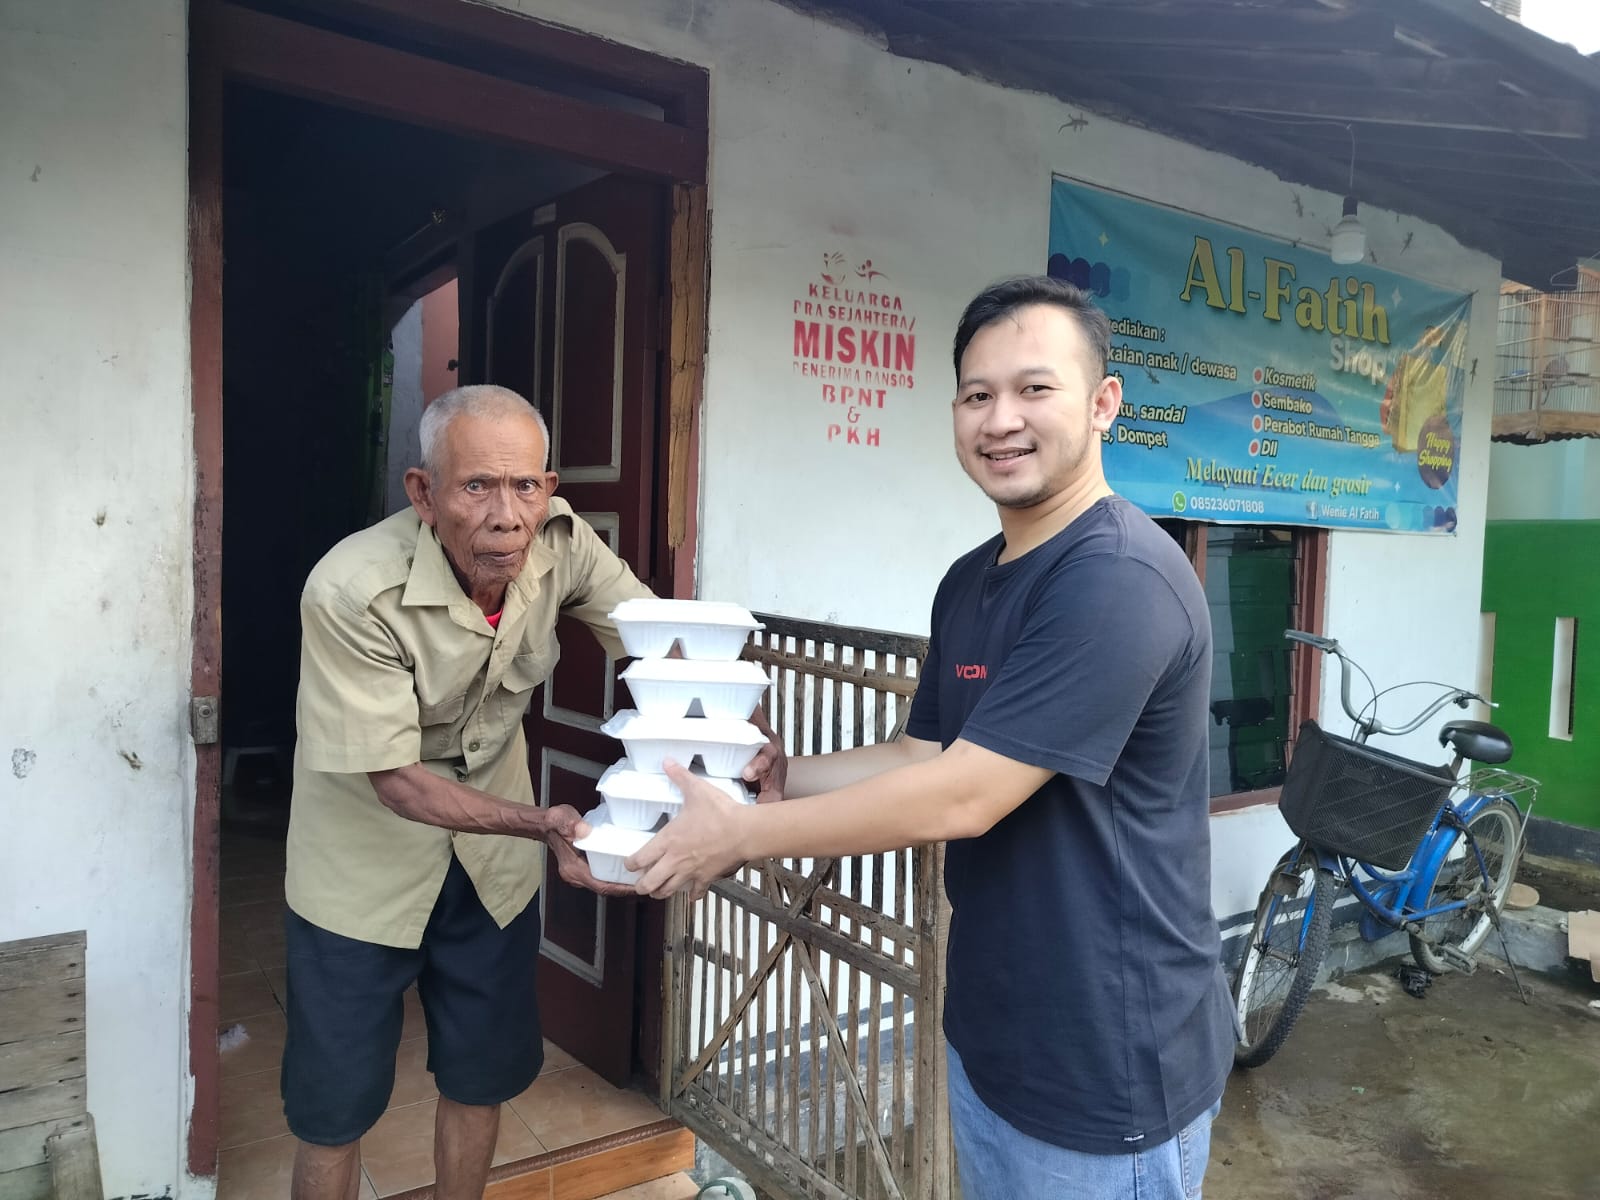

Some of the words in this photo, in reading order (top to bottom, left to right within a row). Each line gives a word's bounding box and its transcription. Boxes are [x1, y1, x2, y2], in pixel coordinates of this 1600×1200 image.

[808, 283, 902, 311] KELUARGA
[1180, 235, 1390, 344] Al-Fatih
[794, 319, 915, 371] MISKIN
[1147, 352, 1179, 371] anak
[1191, 358, 1238, 380] dewasa
[1330, 337, 1388, 386] Shop
[1264, 368, 1317, 391] Kosmetik
[823, 384, 887, 409] BPNT
[1263, 392, 1313, 414] Sembako
[847, 406, 860, 423] &
[1140, 404, 1187, 423] sandal
[828, 424, 880, 447] PKH
[1117, 425, 1168, 448] Dompet
[1264, 415, 1306, 436] Perabot
[1308, 421, 1344, 441] Rumah
[1345, 427, 1381, 448] Tangga
[1426, 431, 1451, 454] Happy
[1418, 448, 1453, 473] Shopping
[1185, 457, 1259, 488] Melayani
[1262, 464, 1299, 488] Ecer
[1302, 469, 1328, 491] dan
[1330, 474, 1372, 498] grosir
[1360, 506, 1380, 521] Fatih
